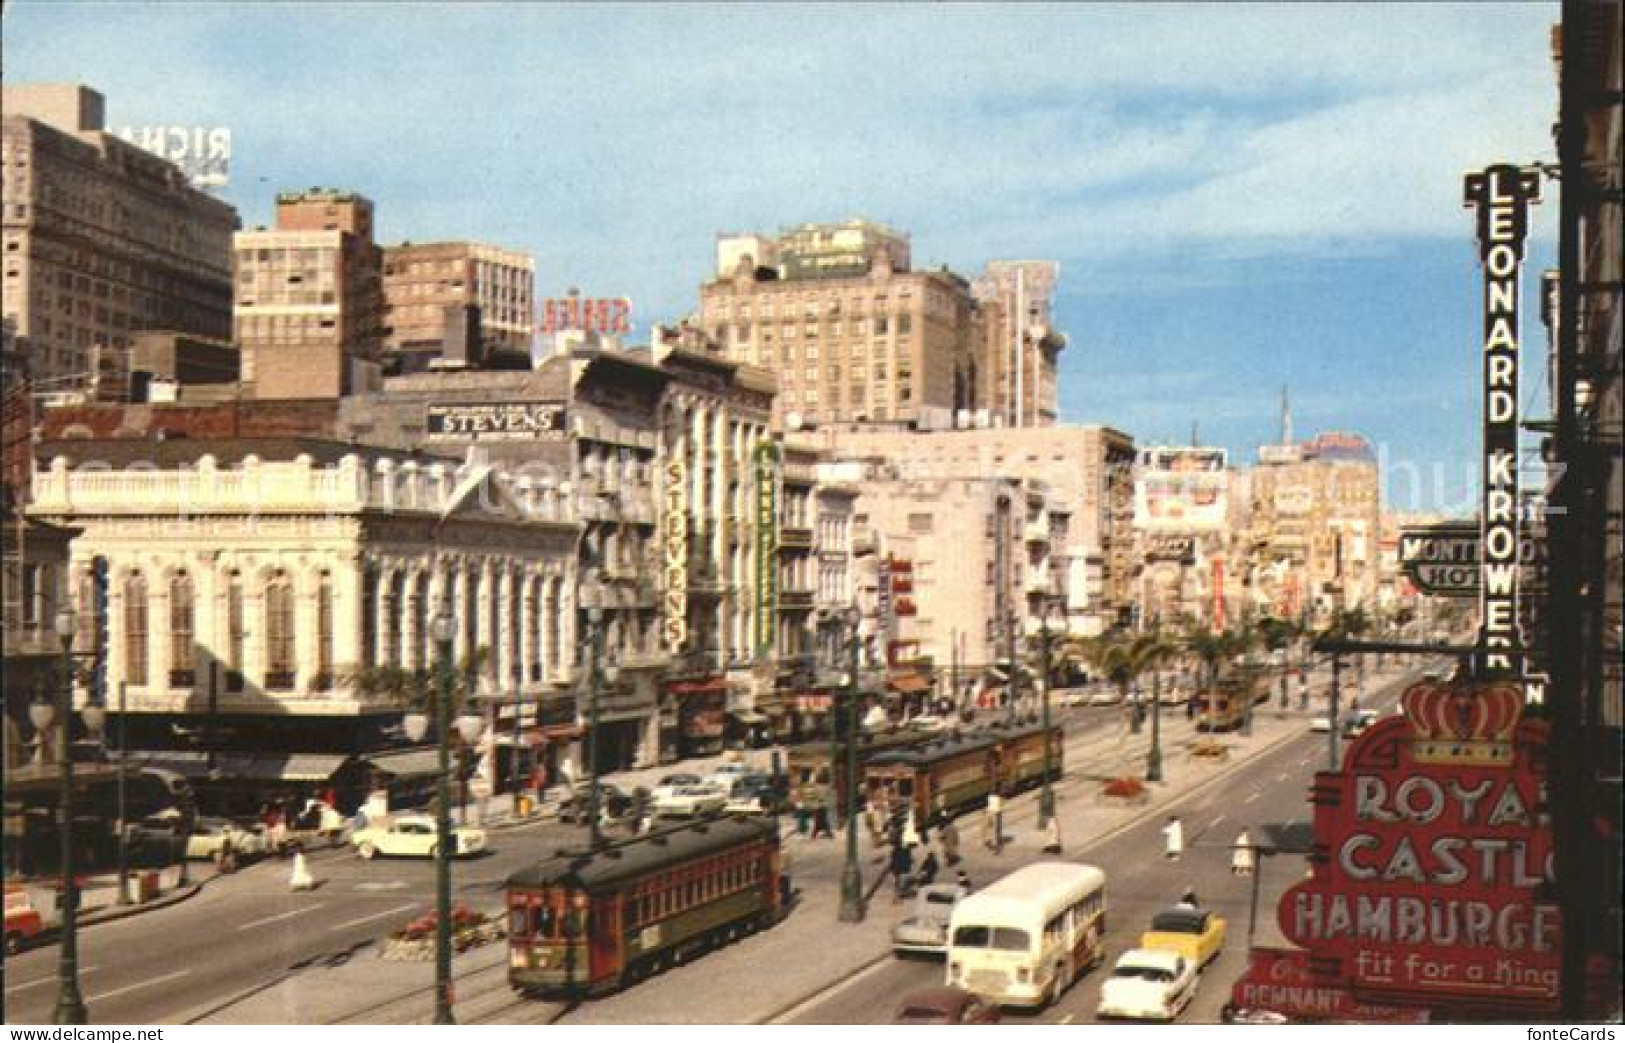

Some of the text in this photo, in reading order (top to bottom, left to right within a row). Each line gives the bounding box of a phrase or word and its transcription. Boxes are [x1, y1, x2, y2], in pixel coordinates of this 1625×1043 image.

[444, 414, 551, 431] STEVENS
[1487, 172, 1517, 668] LEONARD KROWER
[667, 463, 683, 641] STEVENS
[1339, 834, 1556, 888] CASTL
[1405, 954, 1450, 983] for
[1467, 966, 1483, 980] a
